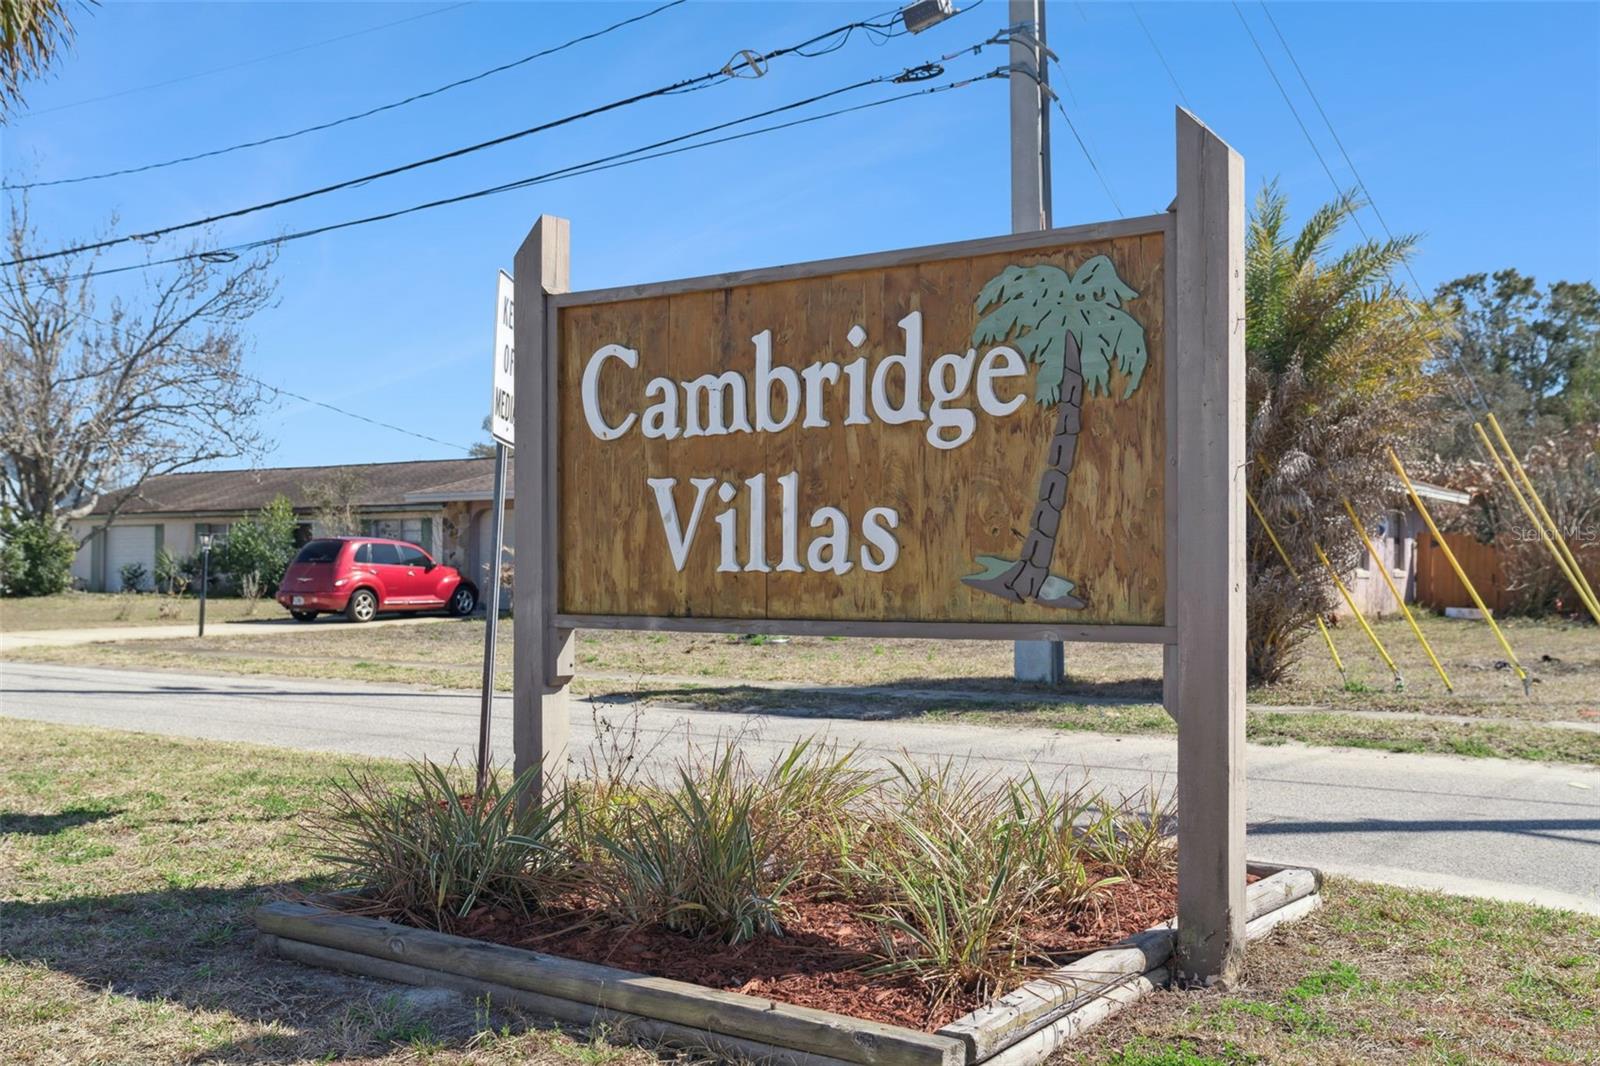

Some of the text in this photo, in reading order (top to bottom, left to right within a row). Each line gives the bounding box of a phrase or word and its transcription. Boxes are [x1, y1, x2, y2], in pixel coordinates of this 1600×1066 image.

[503, 295, 514, 329] KE
[503, 344, 514, 376] OF
[581, 310, 1028, 450] Cambridge
[495, 386, 514, 424] MEDI
[646, 471, 899, 575] Villas
